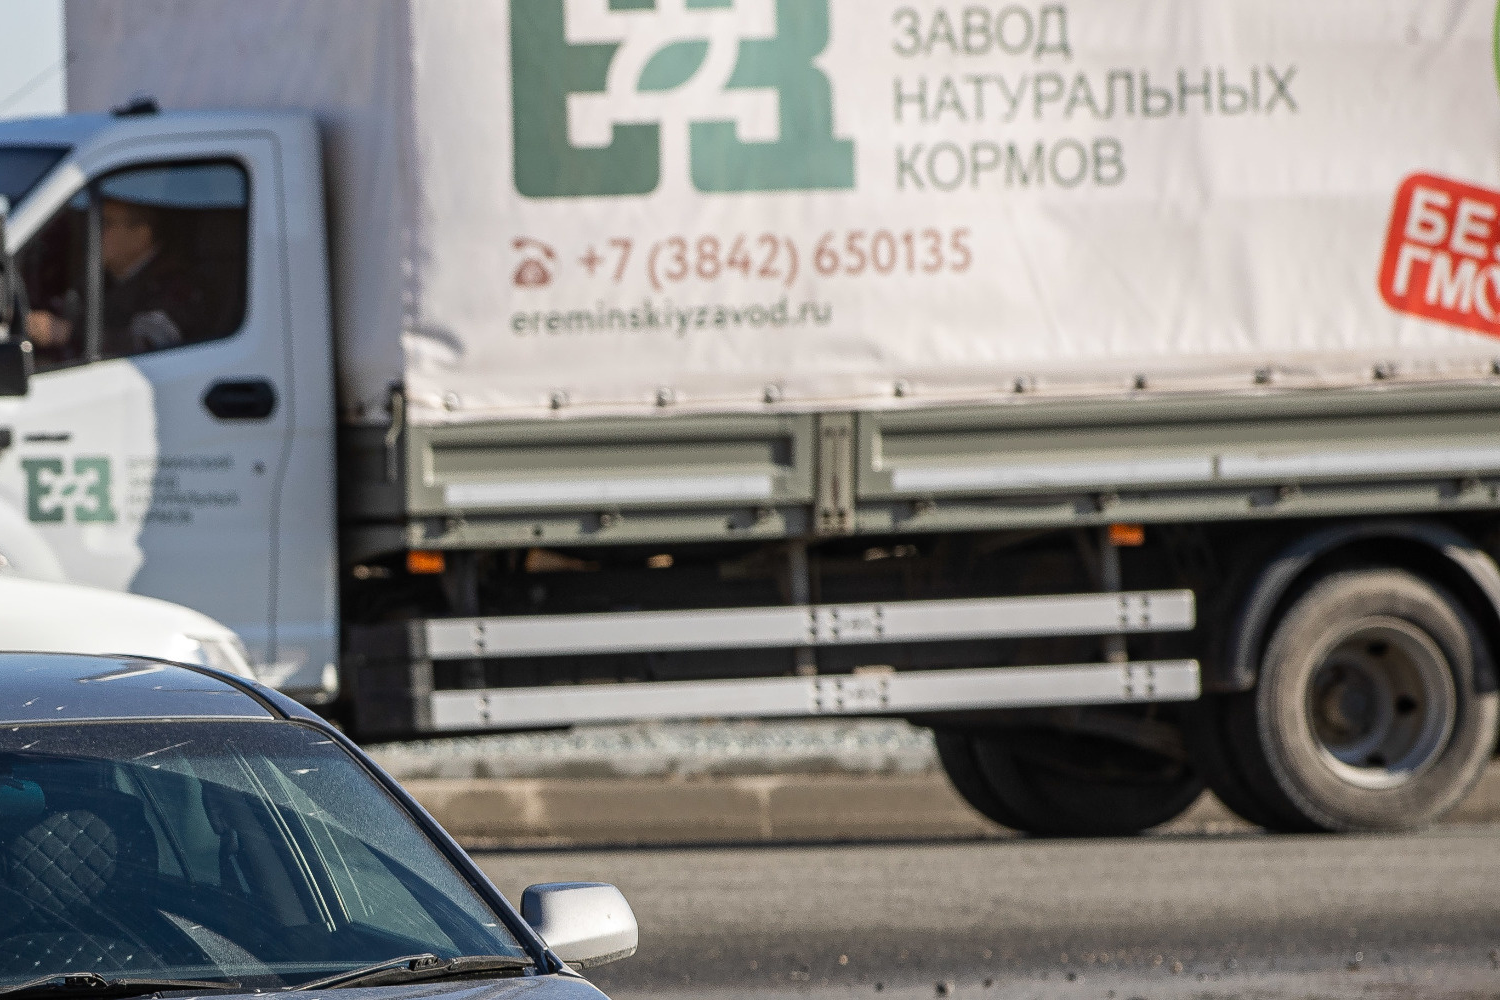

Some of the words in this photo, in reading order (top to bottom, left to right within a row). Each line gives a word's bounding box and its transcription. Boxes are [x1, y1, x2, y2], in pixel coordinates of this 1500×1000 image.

[891, 3, 1073, 62] ЗАВОД
[891, 64, 1299, 124] НАТУРАЛЬНЫХ
[893, 136, 1127, 193] КОРМОВ
[1405, 185, 1500, 263] БЕ
[577, 235, 635, 285] +7
[646, 232, 799, 293] (3842)
[812, 227, 975, 278] 650135
[509, 298, 834, 339] ereminskiyzavod.ru
